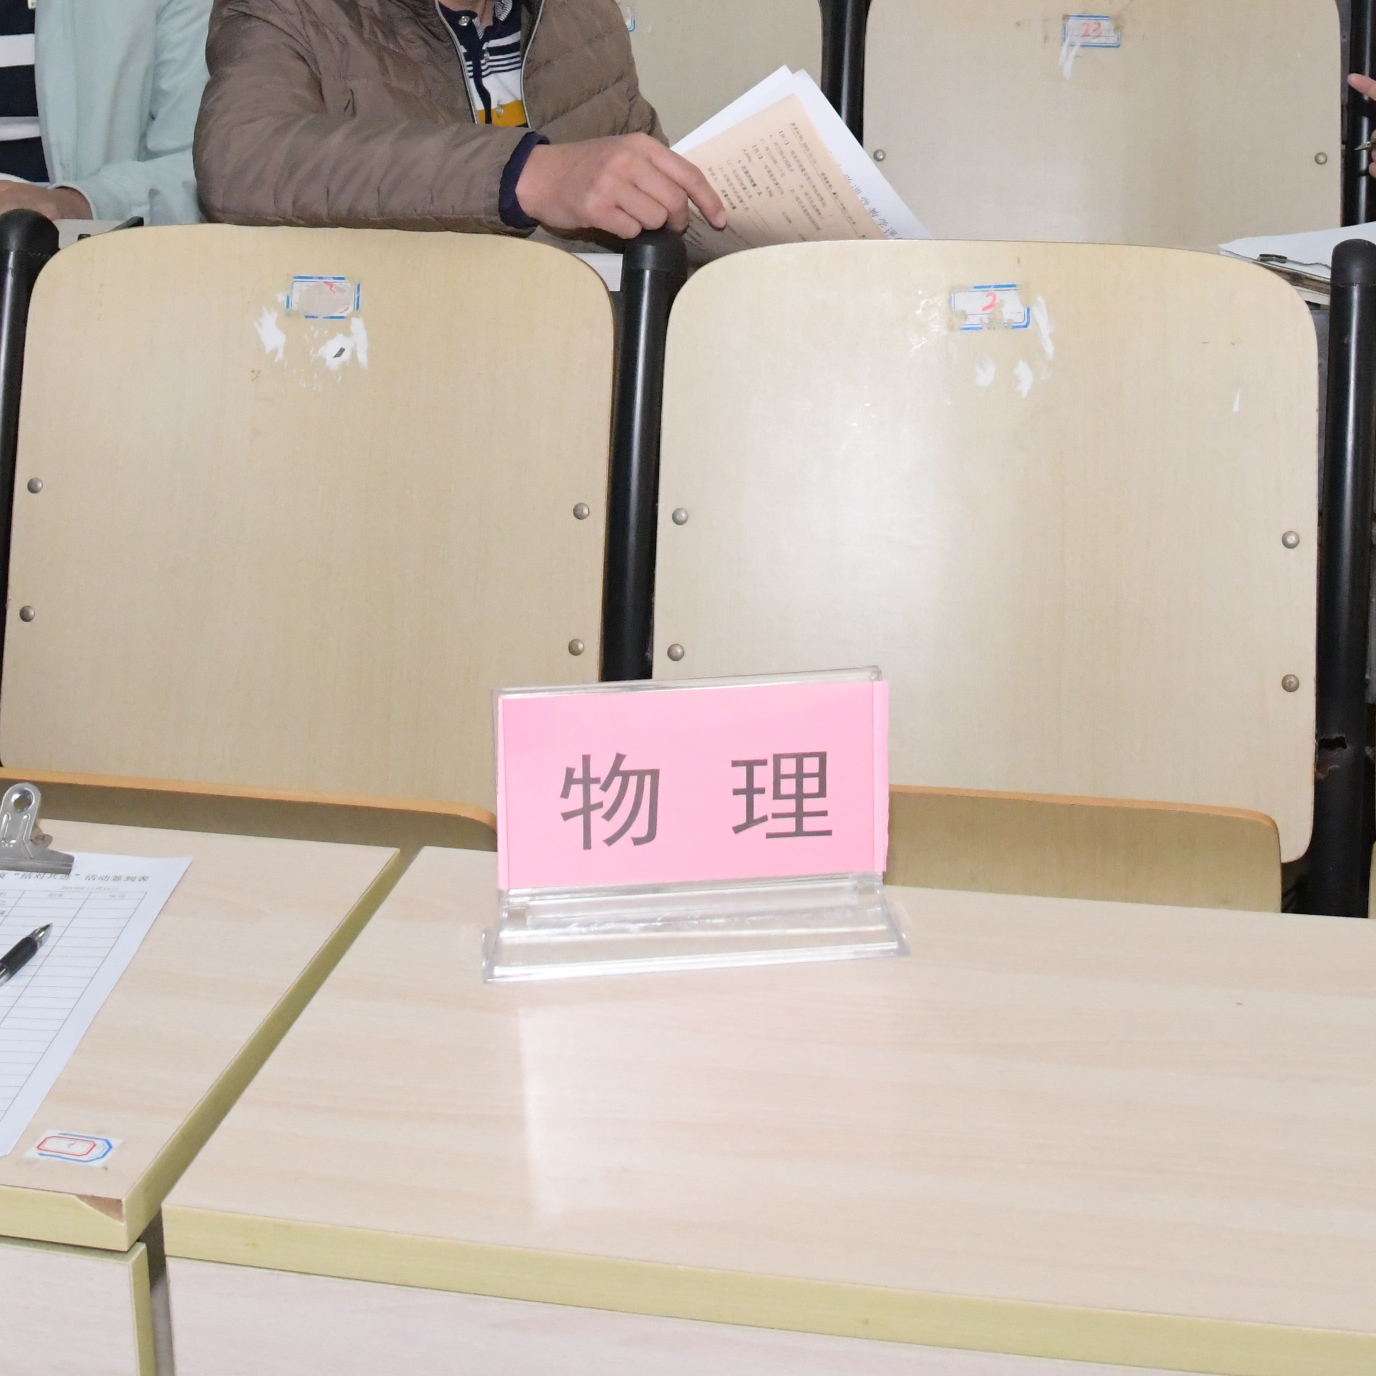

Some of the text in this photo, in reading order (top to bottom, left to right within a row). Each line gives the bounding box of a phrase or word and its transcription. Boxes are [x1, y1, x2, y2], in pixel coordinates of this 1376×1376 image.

[1080, 22, 1103, 40] 23
[982, 292, 997, 312] 2
[559, 751, 833, 851] 物理
